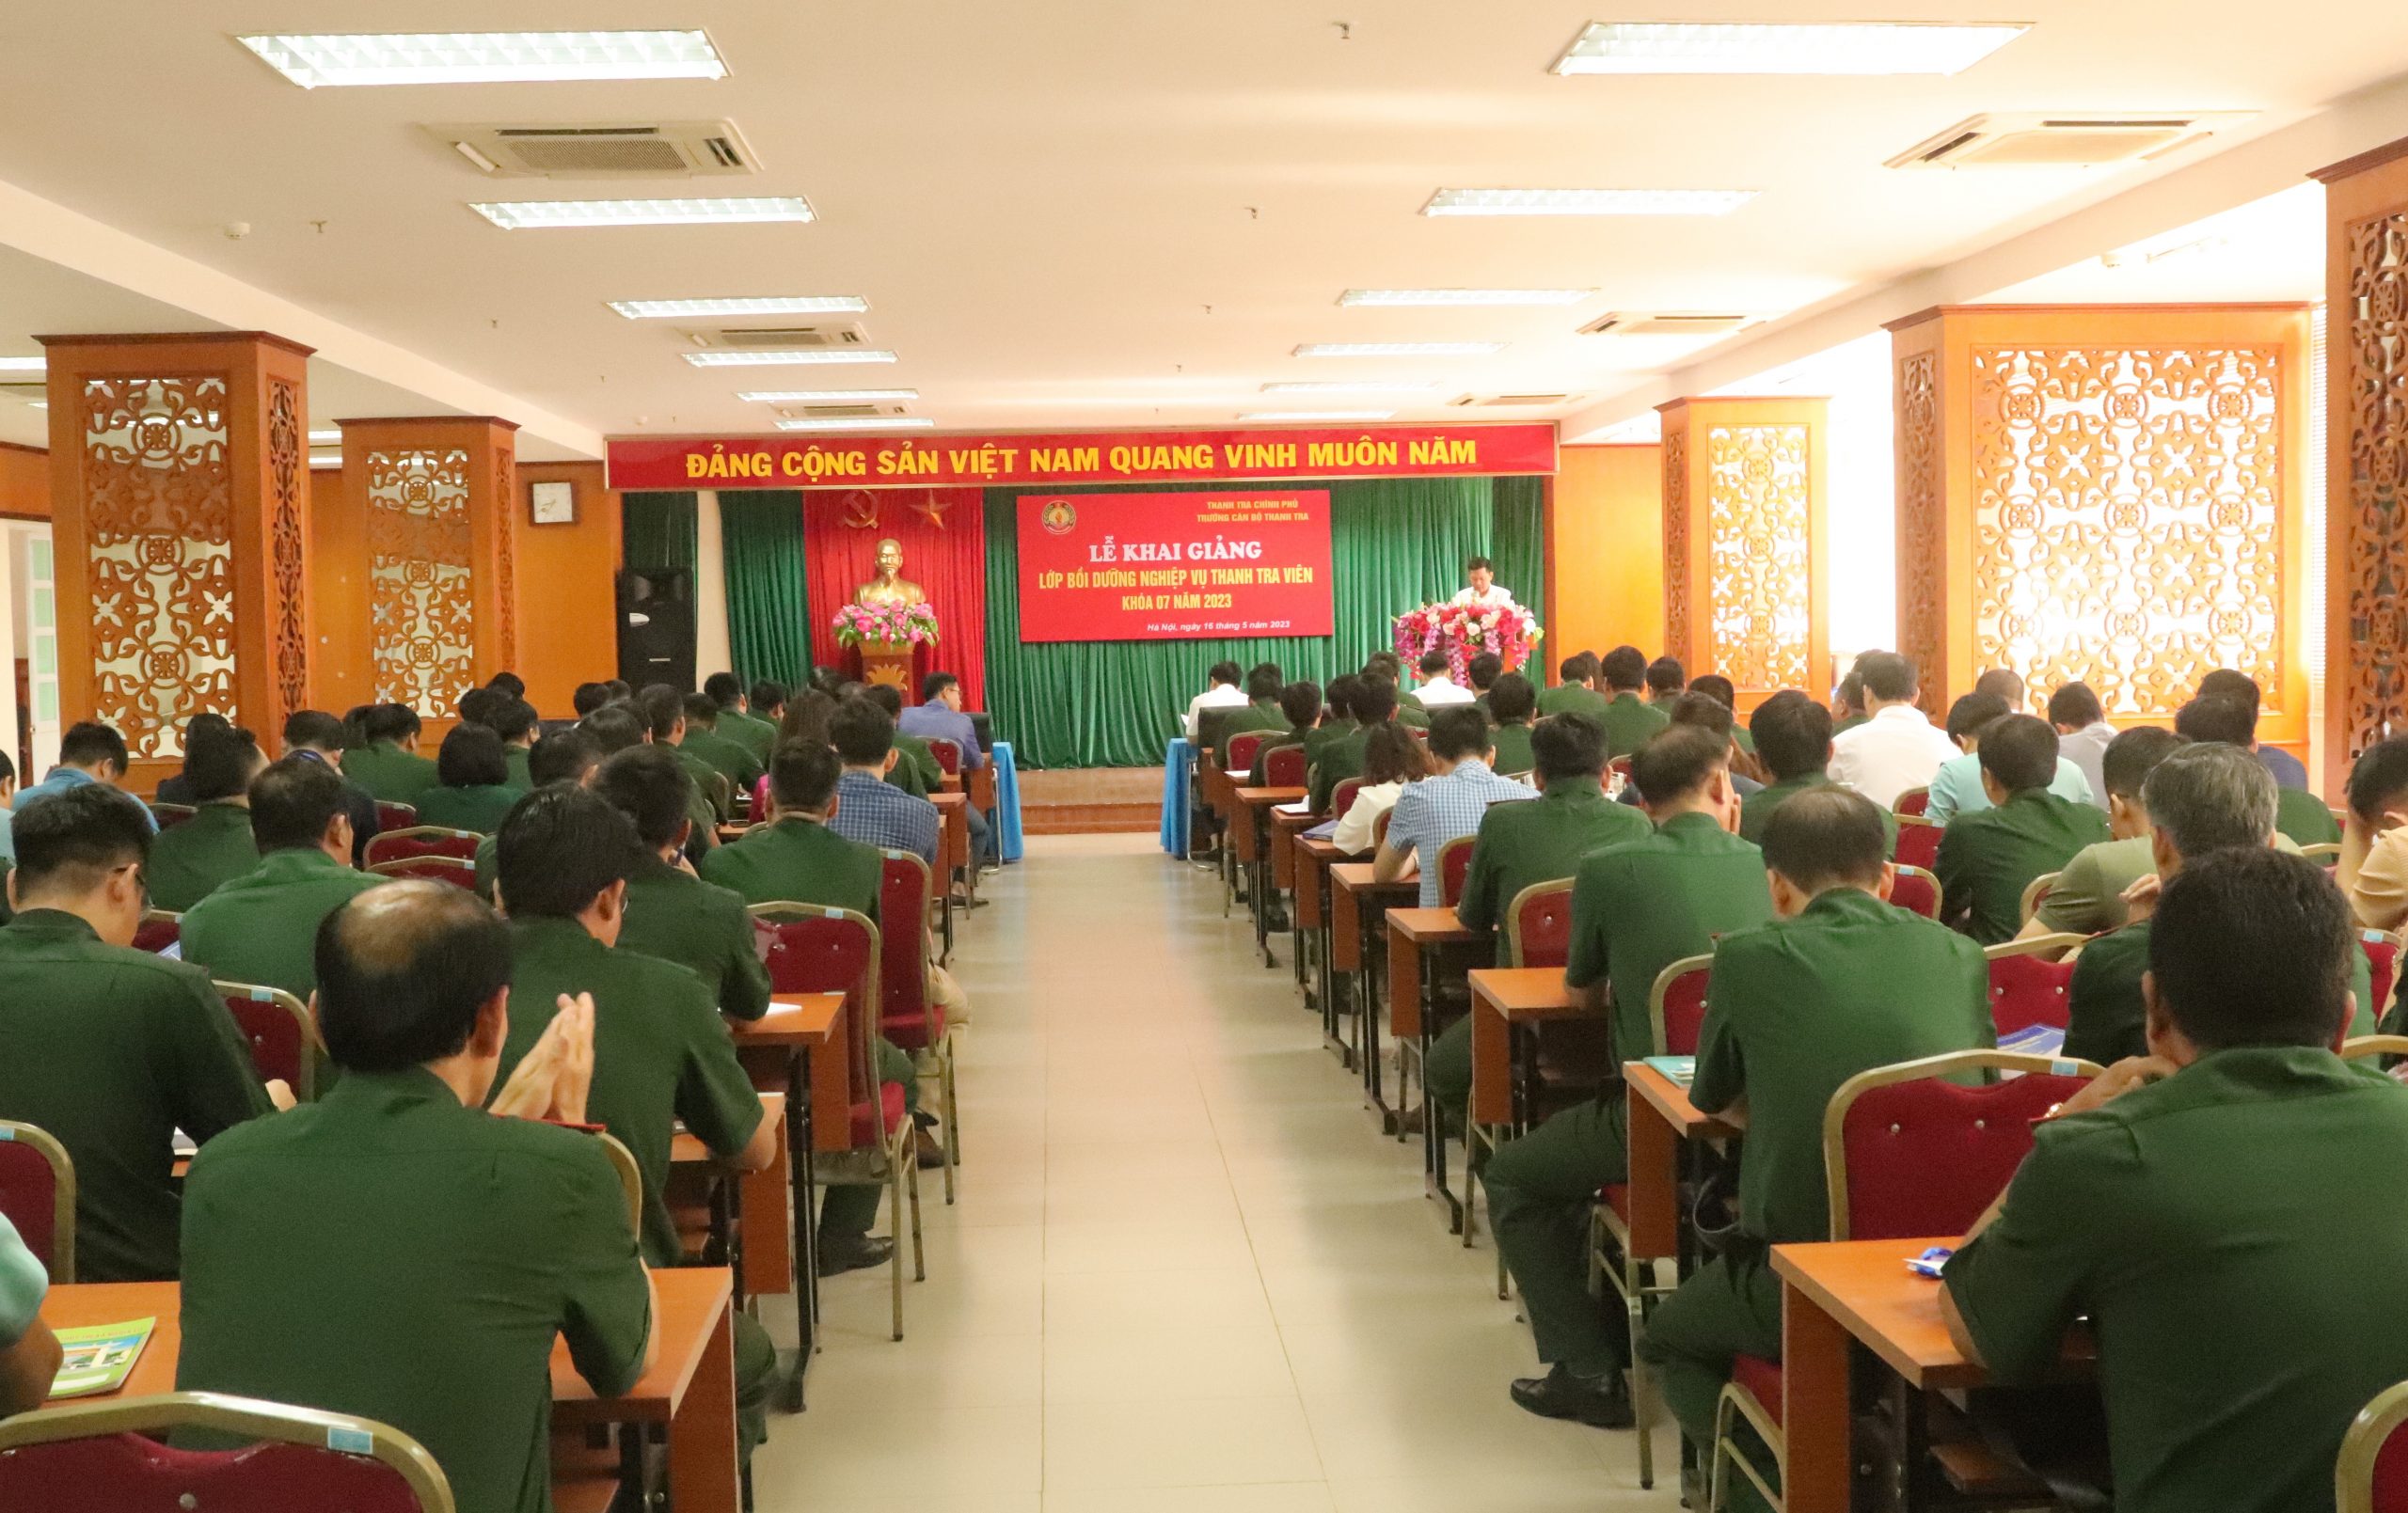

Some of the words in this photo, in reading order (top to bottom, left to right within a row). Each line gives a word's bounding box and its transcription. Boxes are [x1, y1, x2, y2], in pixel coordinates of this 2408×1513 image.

[686, 443, 772, 478] ĐẢNG
[782, 445, 866, 482] CỘNG
[877, 440, 939, 474] SẢN
[948, 442, 1019, 481] VIỆT
[1030, 447, 1100, 472] NAM
[1109, 444, 1214, 474] QUANG
[1224, 443, 1296, 468] VINH
[1307, 434, 1398, 467] MUÔN
[1408, 435, 1477, 465] NĂM
[1264, 512, 1291, 522] THANH
[1293, 512, 1309, 522] TRA
[1089, 535, 1117, 562] LỄ
[1122, 543, 1182, 562] KHAI
[1187, 534, 1262, 561] GIẢNG
[1038, 569, 1064, 590] LỚP
[1067, 567, 1088, 589] BỒI
[1092, 567, 1136, 588] DƯỠNG
[1139, 567, 1187, 590] NGHIỆP
[1190, 568, 1207, 591] VỤ
[1210, 567, 1253, 585] THANH
[1256, 567, 1281, 584] TRA
[1282, 563, 1314, 584] VIÊN
[1121, 592, 1154, 611] KHÓA
[1155, 594, 1171, 610] 07
[1173, 591, 1201, 609] NĂM
[1203, 593, 1232, 609] 2023
[1147, 623, 1160, 632] Hà
[1180, 623, 1201, 633] ngày
[1203, 622, 1213, 630] 16
[1215, 622, 1240, 631] tháng
[1270, 620, 1291, 629] 2023
